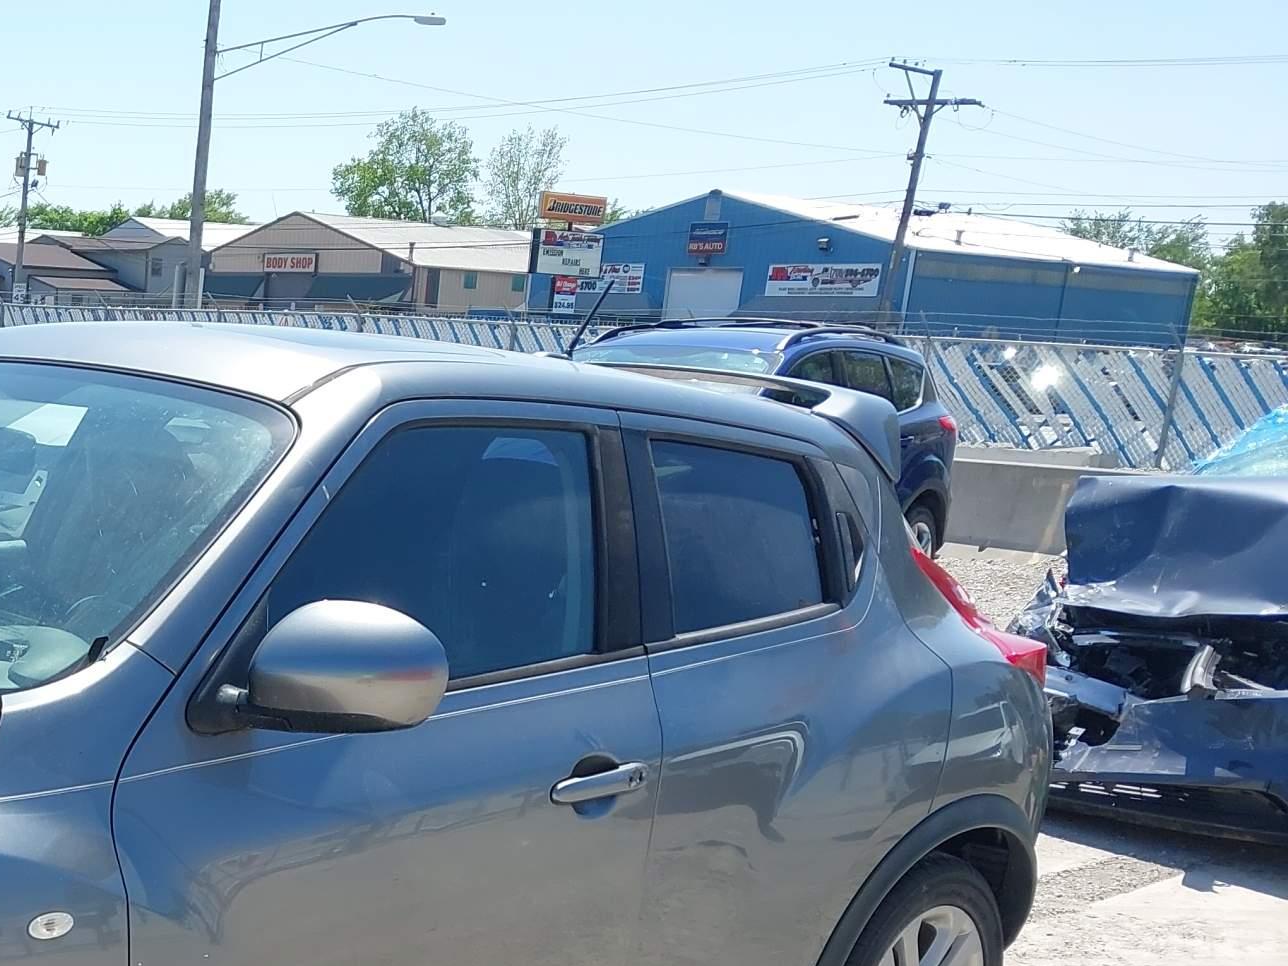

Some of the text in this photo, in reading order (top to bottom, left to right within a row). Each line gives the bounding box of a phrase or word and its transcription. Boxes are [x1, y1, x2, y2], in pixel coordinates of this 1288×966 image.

[548, 199, 603, 216] BRIDGESTONE
[703, 242, 723, 250] AUTO
[266, 257, 313, 269] BODY SHOP
[562, 258, 581, 266] REPAIRS
[14, 293, 25, 301] 45
